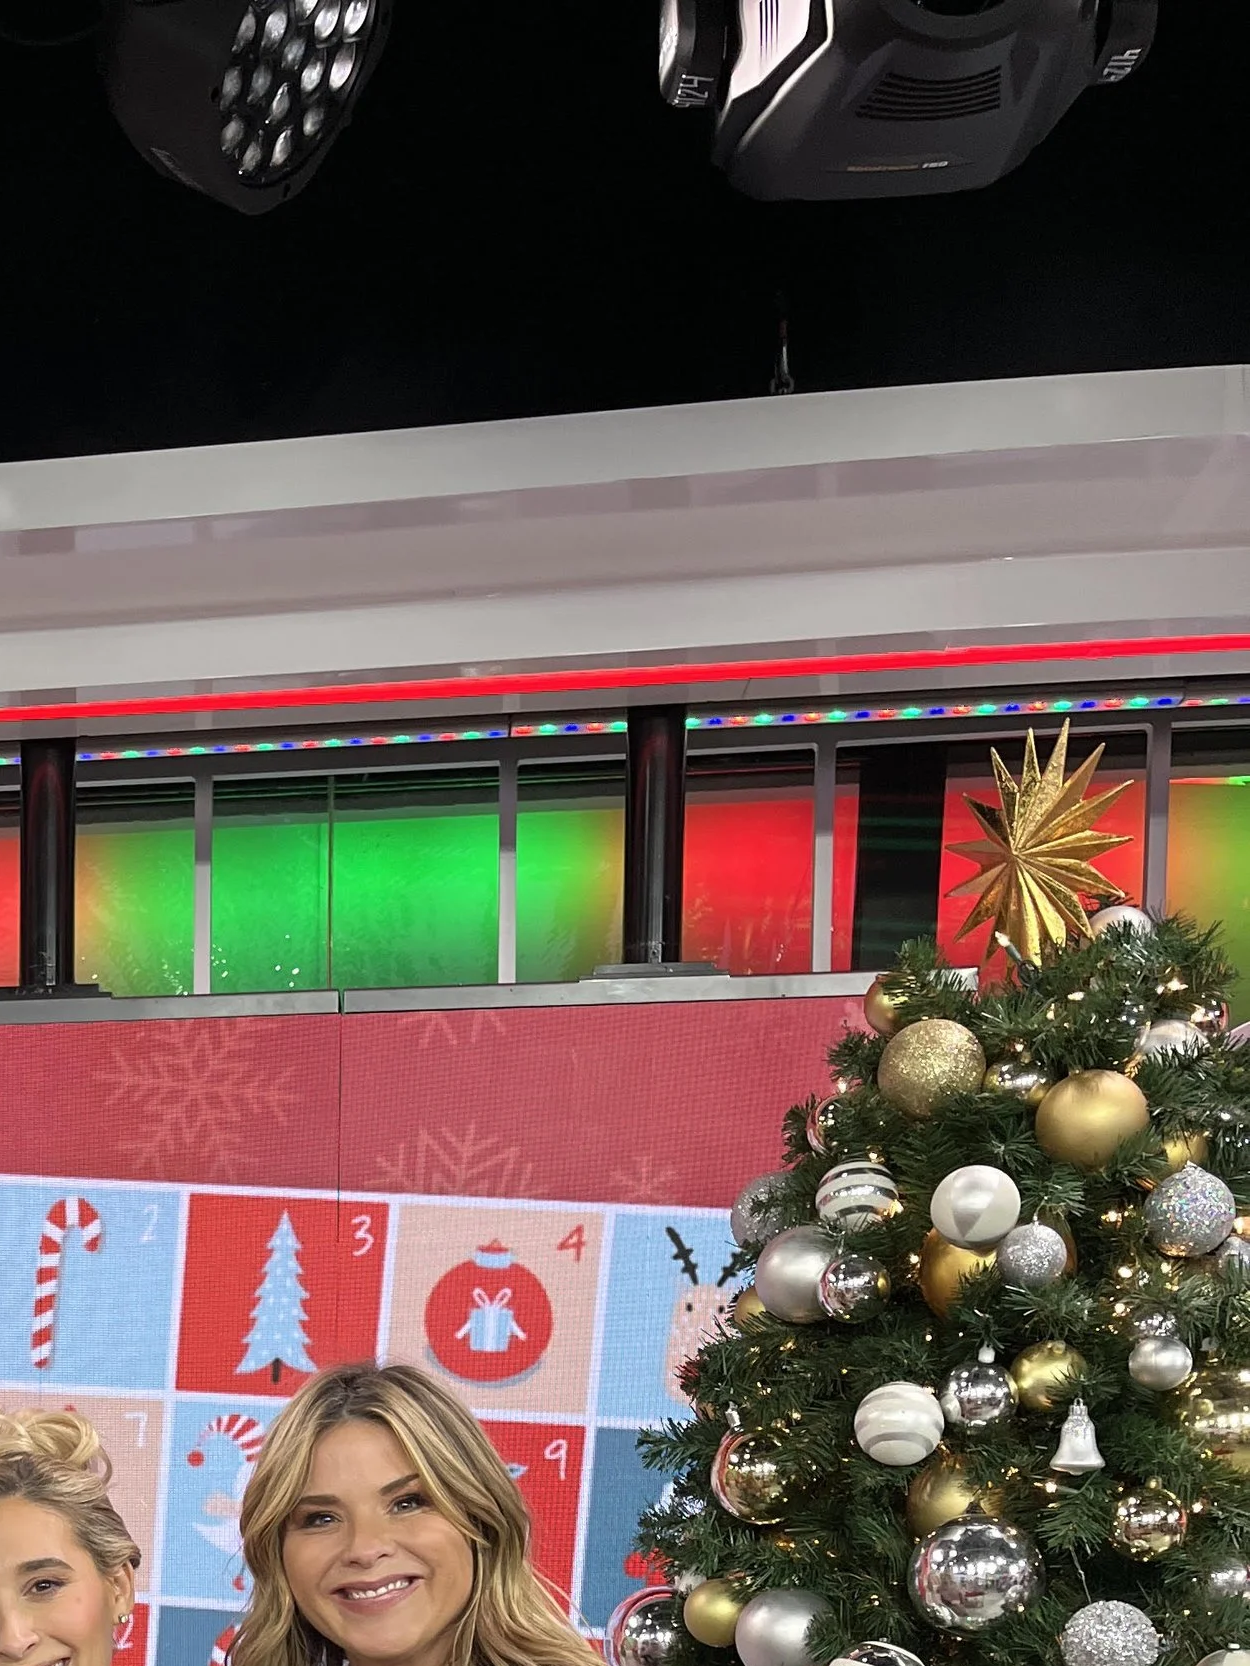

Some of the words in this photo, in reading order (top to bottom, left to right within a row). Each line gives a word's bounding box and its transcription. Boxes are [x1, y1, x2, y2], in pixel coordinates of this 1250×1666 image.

[139, 1204, 159, 1243] 2
[351, 1215, 374, 1256] 3
[557, 1224, 586, 1262] 4
[123, 1411, 148, 1447] 7
[544, 1439, 568, 1480] 9
